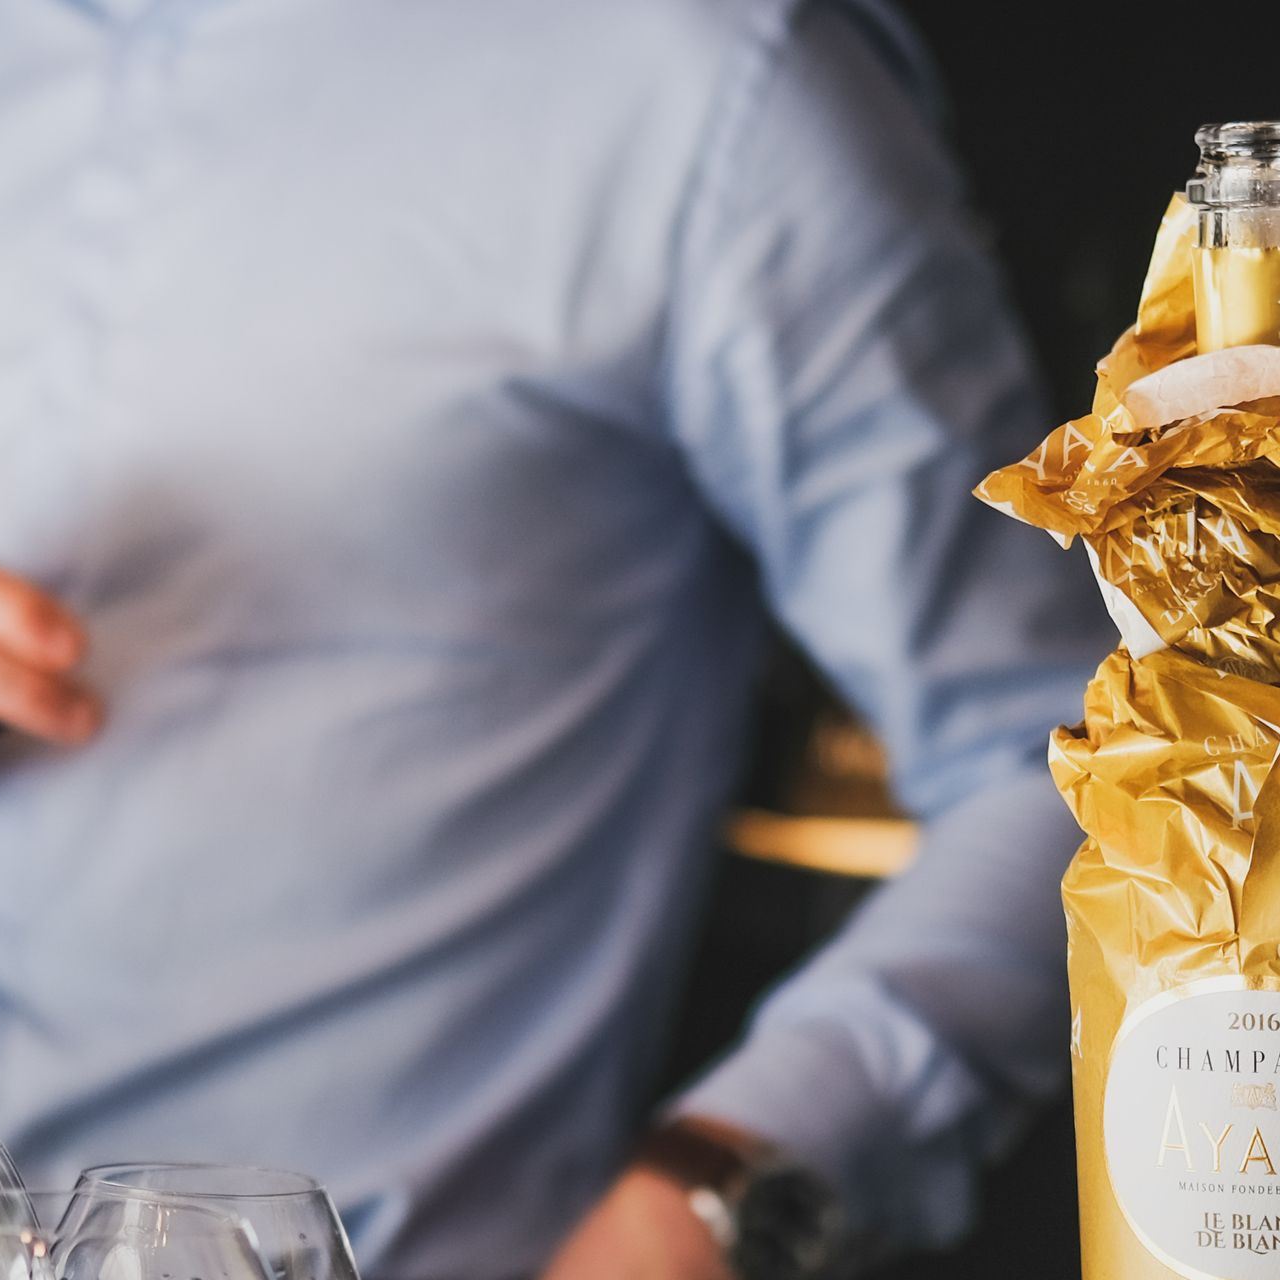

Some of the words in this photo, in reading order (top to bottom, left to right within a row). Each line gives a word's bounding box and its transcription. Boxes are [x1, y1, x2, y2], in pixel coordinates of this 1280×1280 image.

[1227, 1012, 1280, 1032] 2016
[1178, 1181, 1224, 1194] MAISON
[1203, 1212, 1226, 1233] LE
[1194, 1230, 1227, 1249] DE
